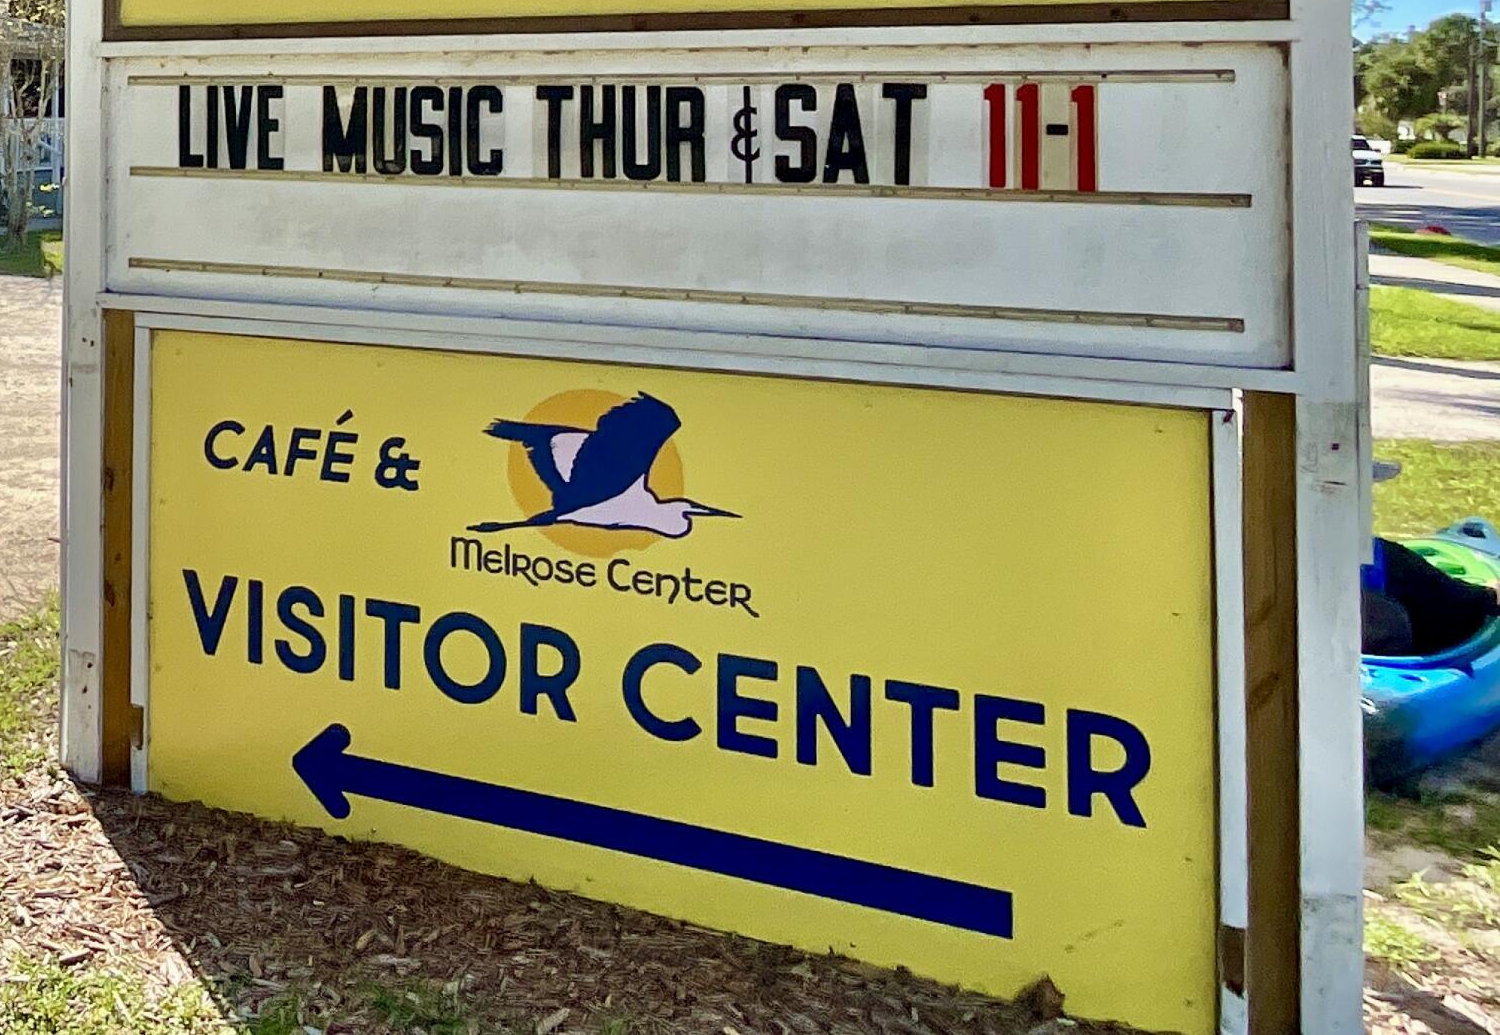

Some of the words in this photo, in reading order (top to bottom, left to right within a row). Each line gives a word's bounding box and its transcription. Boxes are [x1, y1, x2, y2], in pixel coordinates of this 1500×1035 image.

[178, 84, 285, 169] LIVE
[322, 84, 503, 177] MUSIC
[536, 84, 706, 184] THUR
[775, 82, 927, 186] SAT
[982, 83, 1099, 194] 11-1
[204, 410, 358, 483] CAFÉ
[374, 436, 421, 492] &
[182, 568, 582, 723] VISITOR
[620, 642, 1151, 829] CENTER
